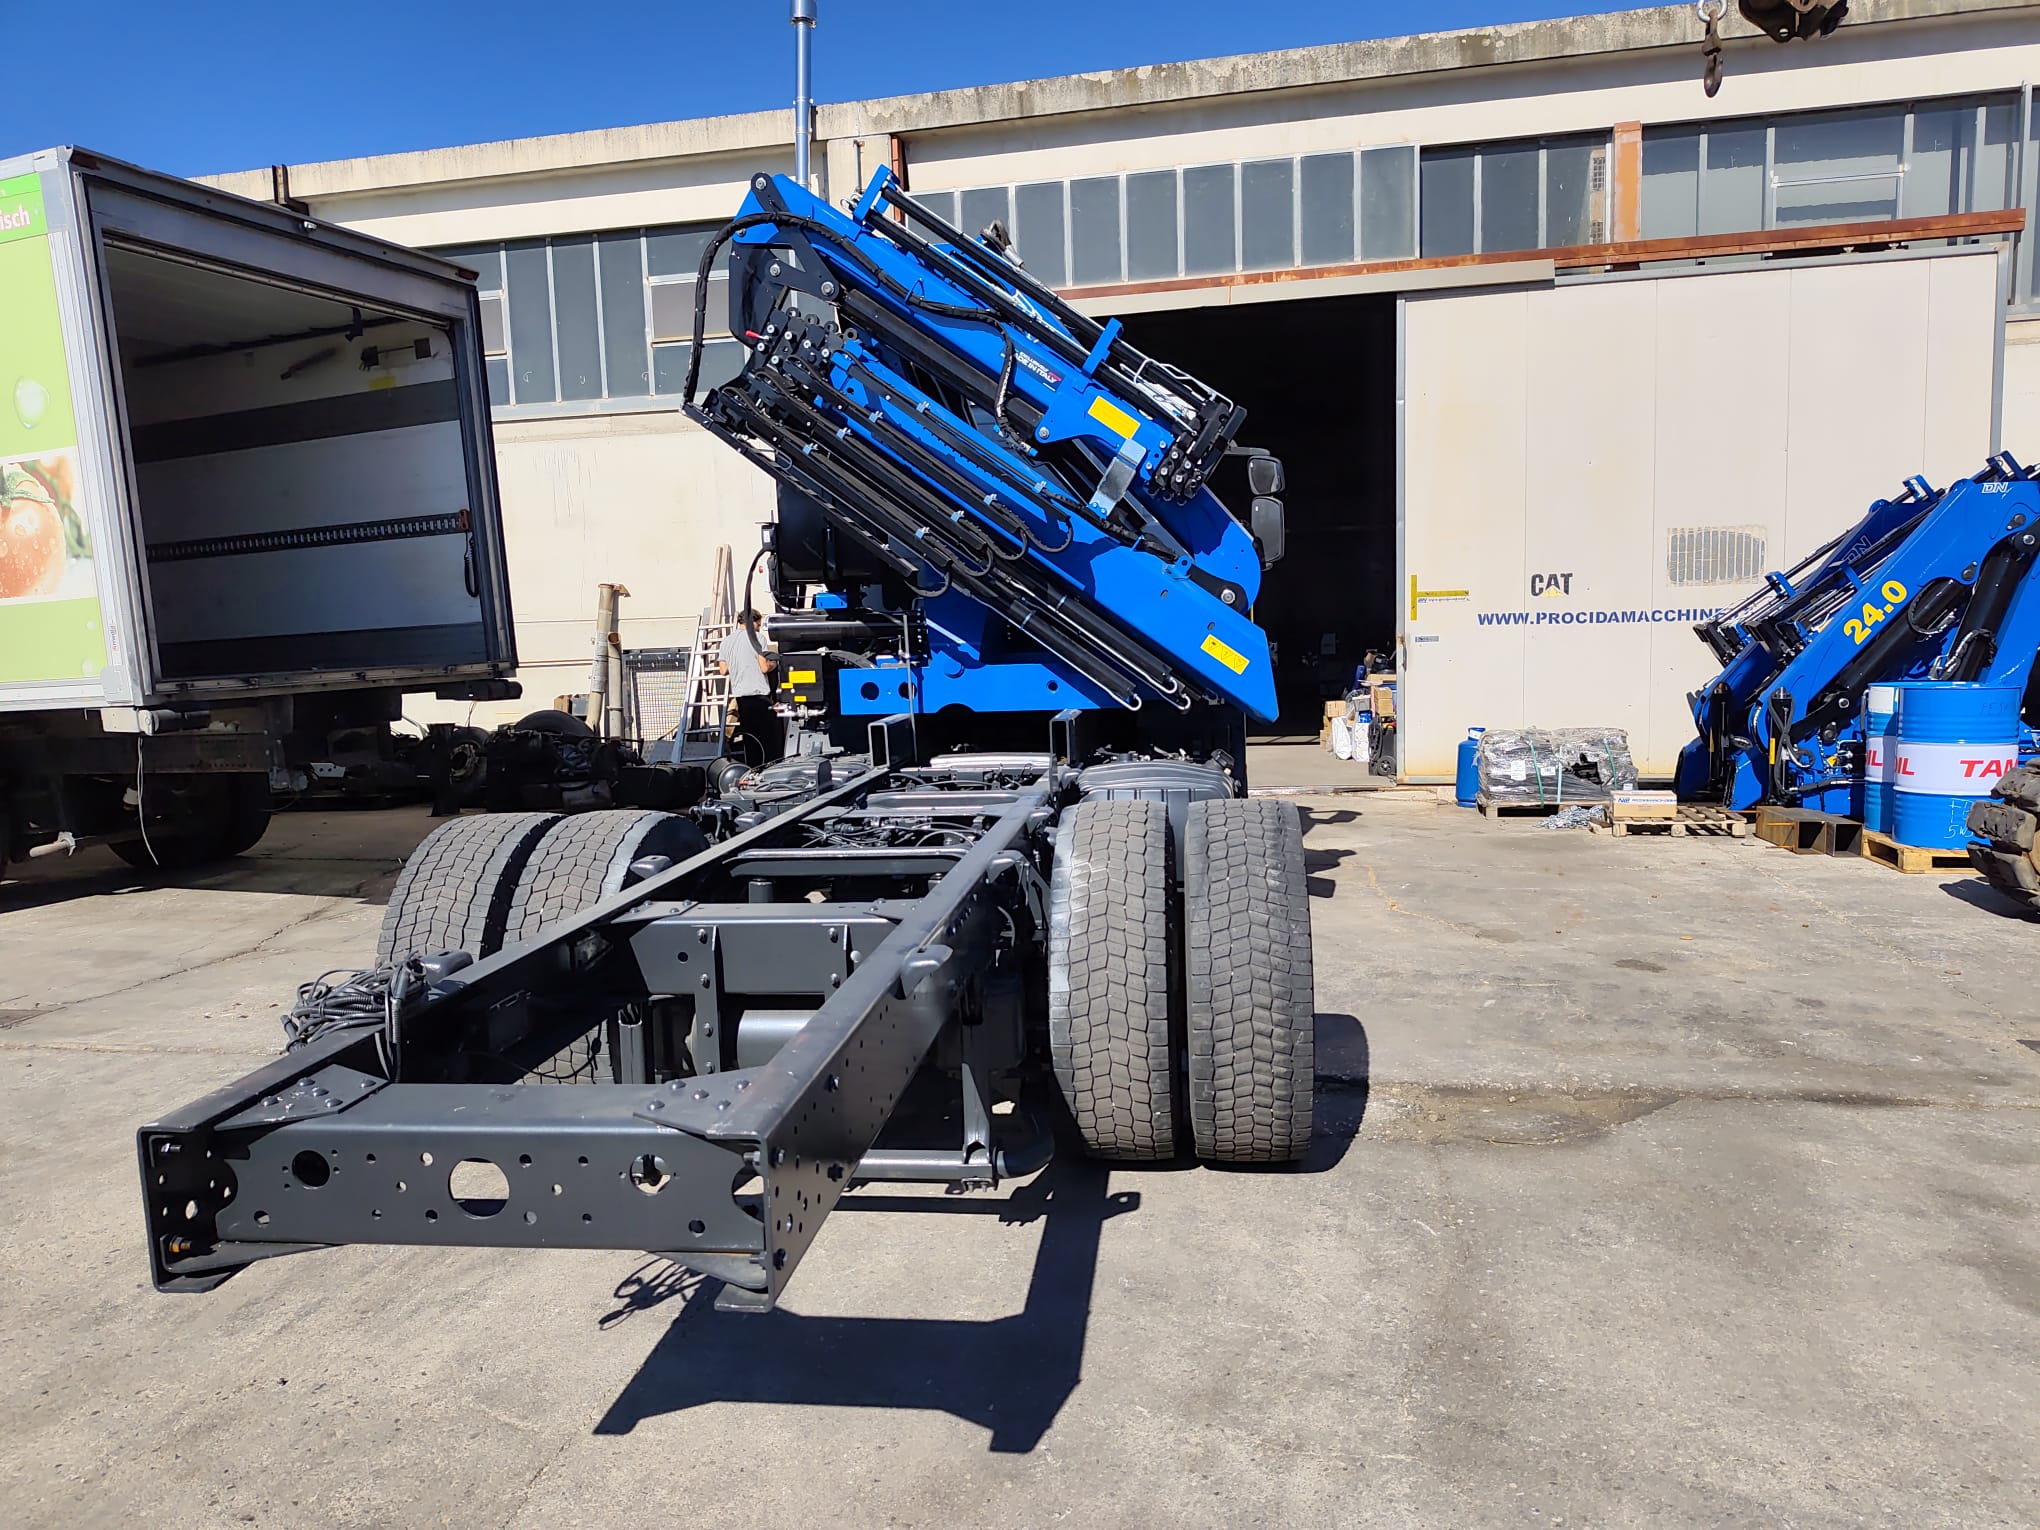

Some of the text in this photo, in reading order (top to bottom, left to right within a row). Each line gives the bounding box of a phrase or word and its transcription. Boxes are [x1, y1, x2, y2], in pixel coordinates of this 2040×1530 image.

[1531, 572, 1574, 597] CAT
[1843, 580, 1908, 646] 24.0
[1866, 749, 1884, 767] IL
[1895, 756, 1915, 776] IL
